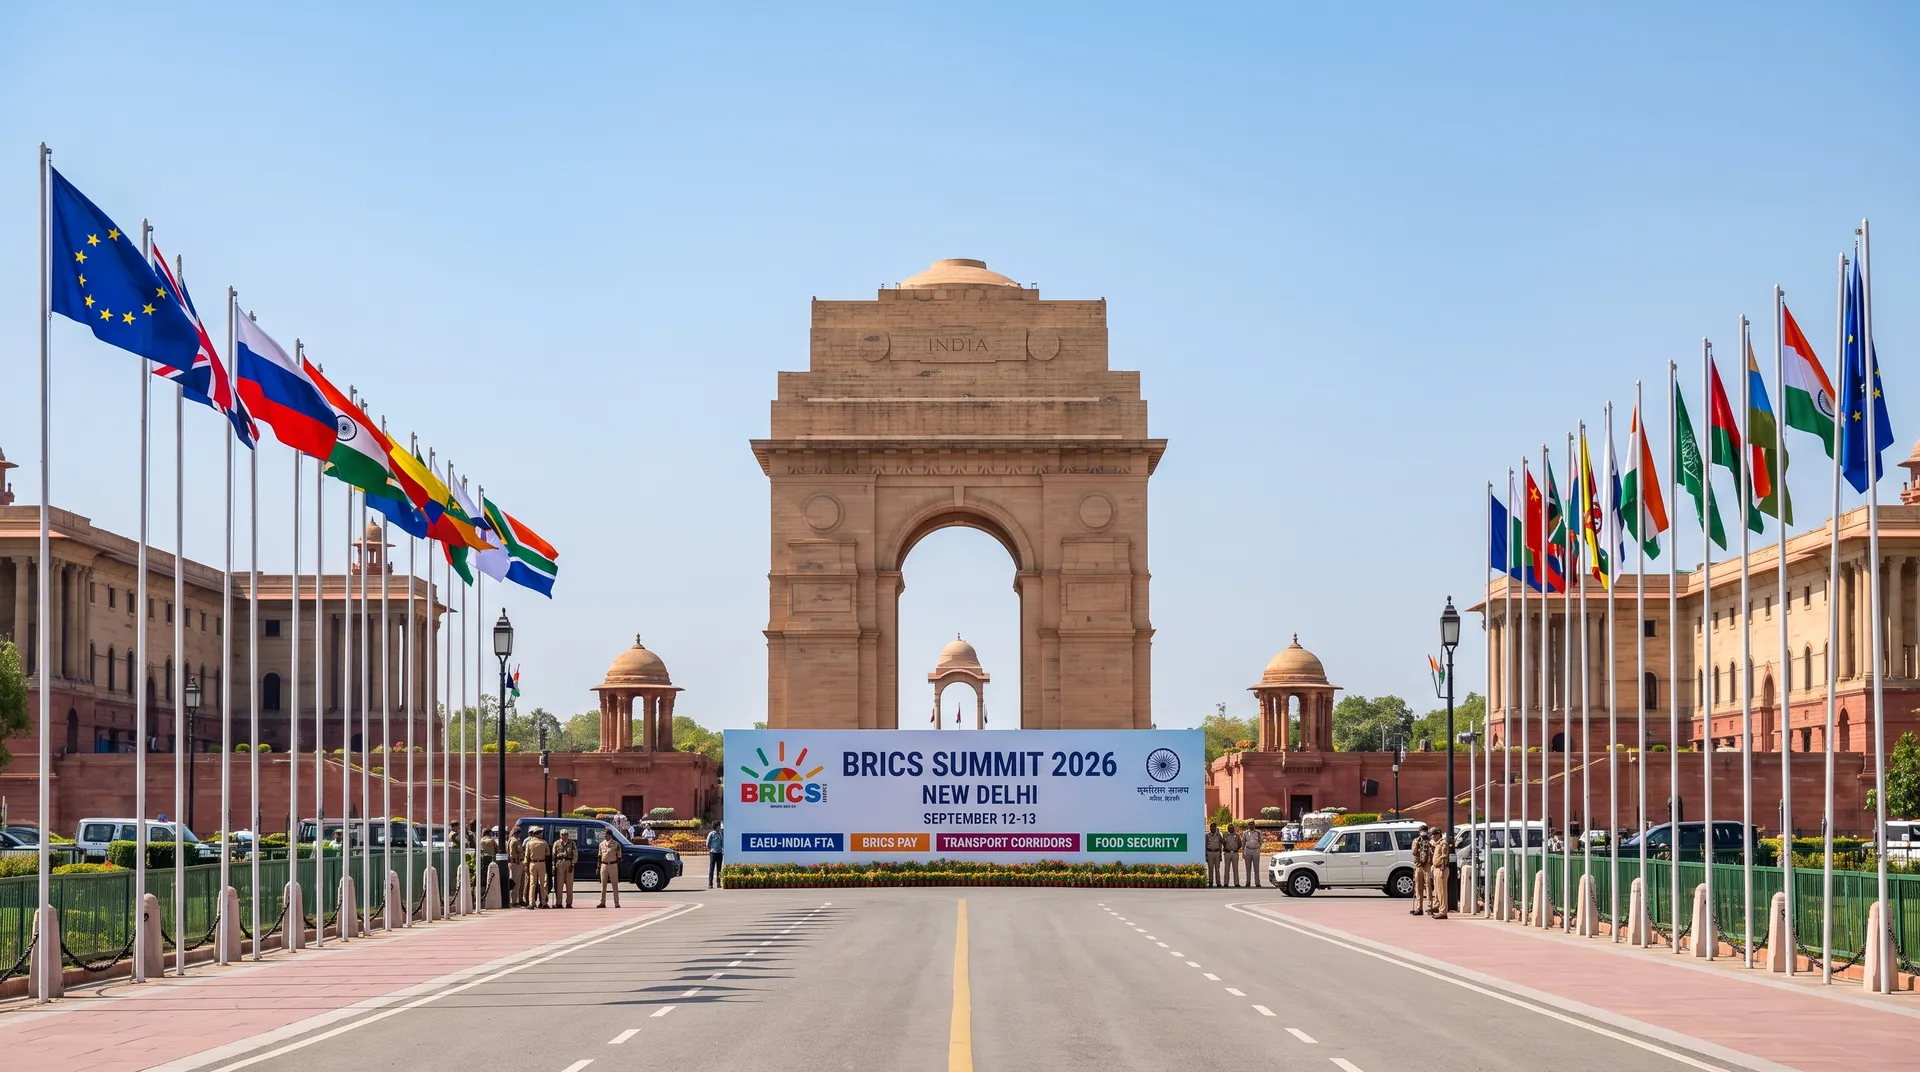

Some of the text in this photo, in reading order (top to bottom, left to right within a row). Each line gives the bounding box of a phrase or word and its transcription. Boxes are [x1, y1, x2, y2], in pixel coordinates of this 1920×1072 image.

[929, 338, 988, 352] INDIA
[844, 752, 1117, 777] BRICS SUMMIT 2026
[741, 782, 821, 803] BRICS
[922, 785, 1037, 804] NEW DELHI
[924, 813, 1036, 824] SEPTEMBER 12-13
[750, 838, 834, 848] EAEU-INDIA FTA
[862, 838, 917, 848] BRICS PAY
[943, 838, 1072, 848] TRANSPORT CORRIDORS
[1095, 838, 1179, 848] FOOD SECURITY
